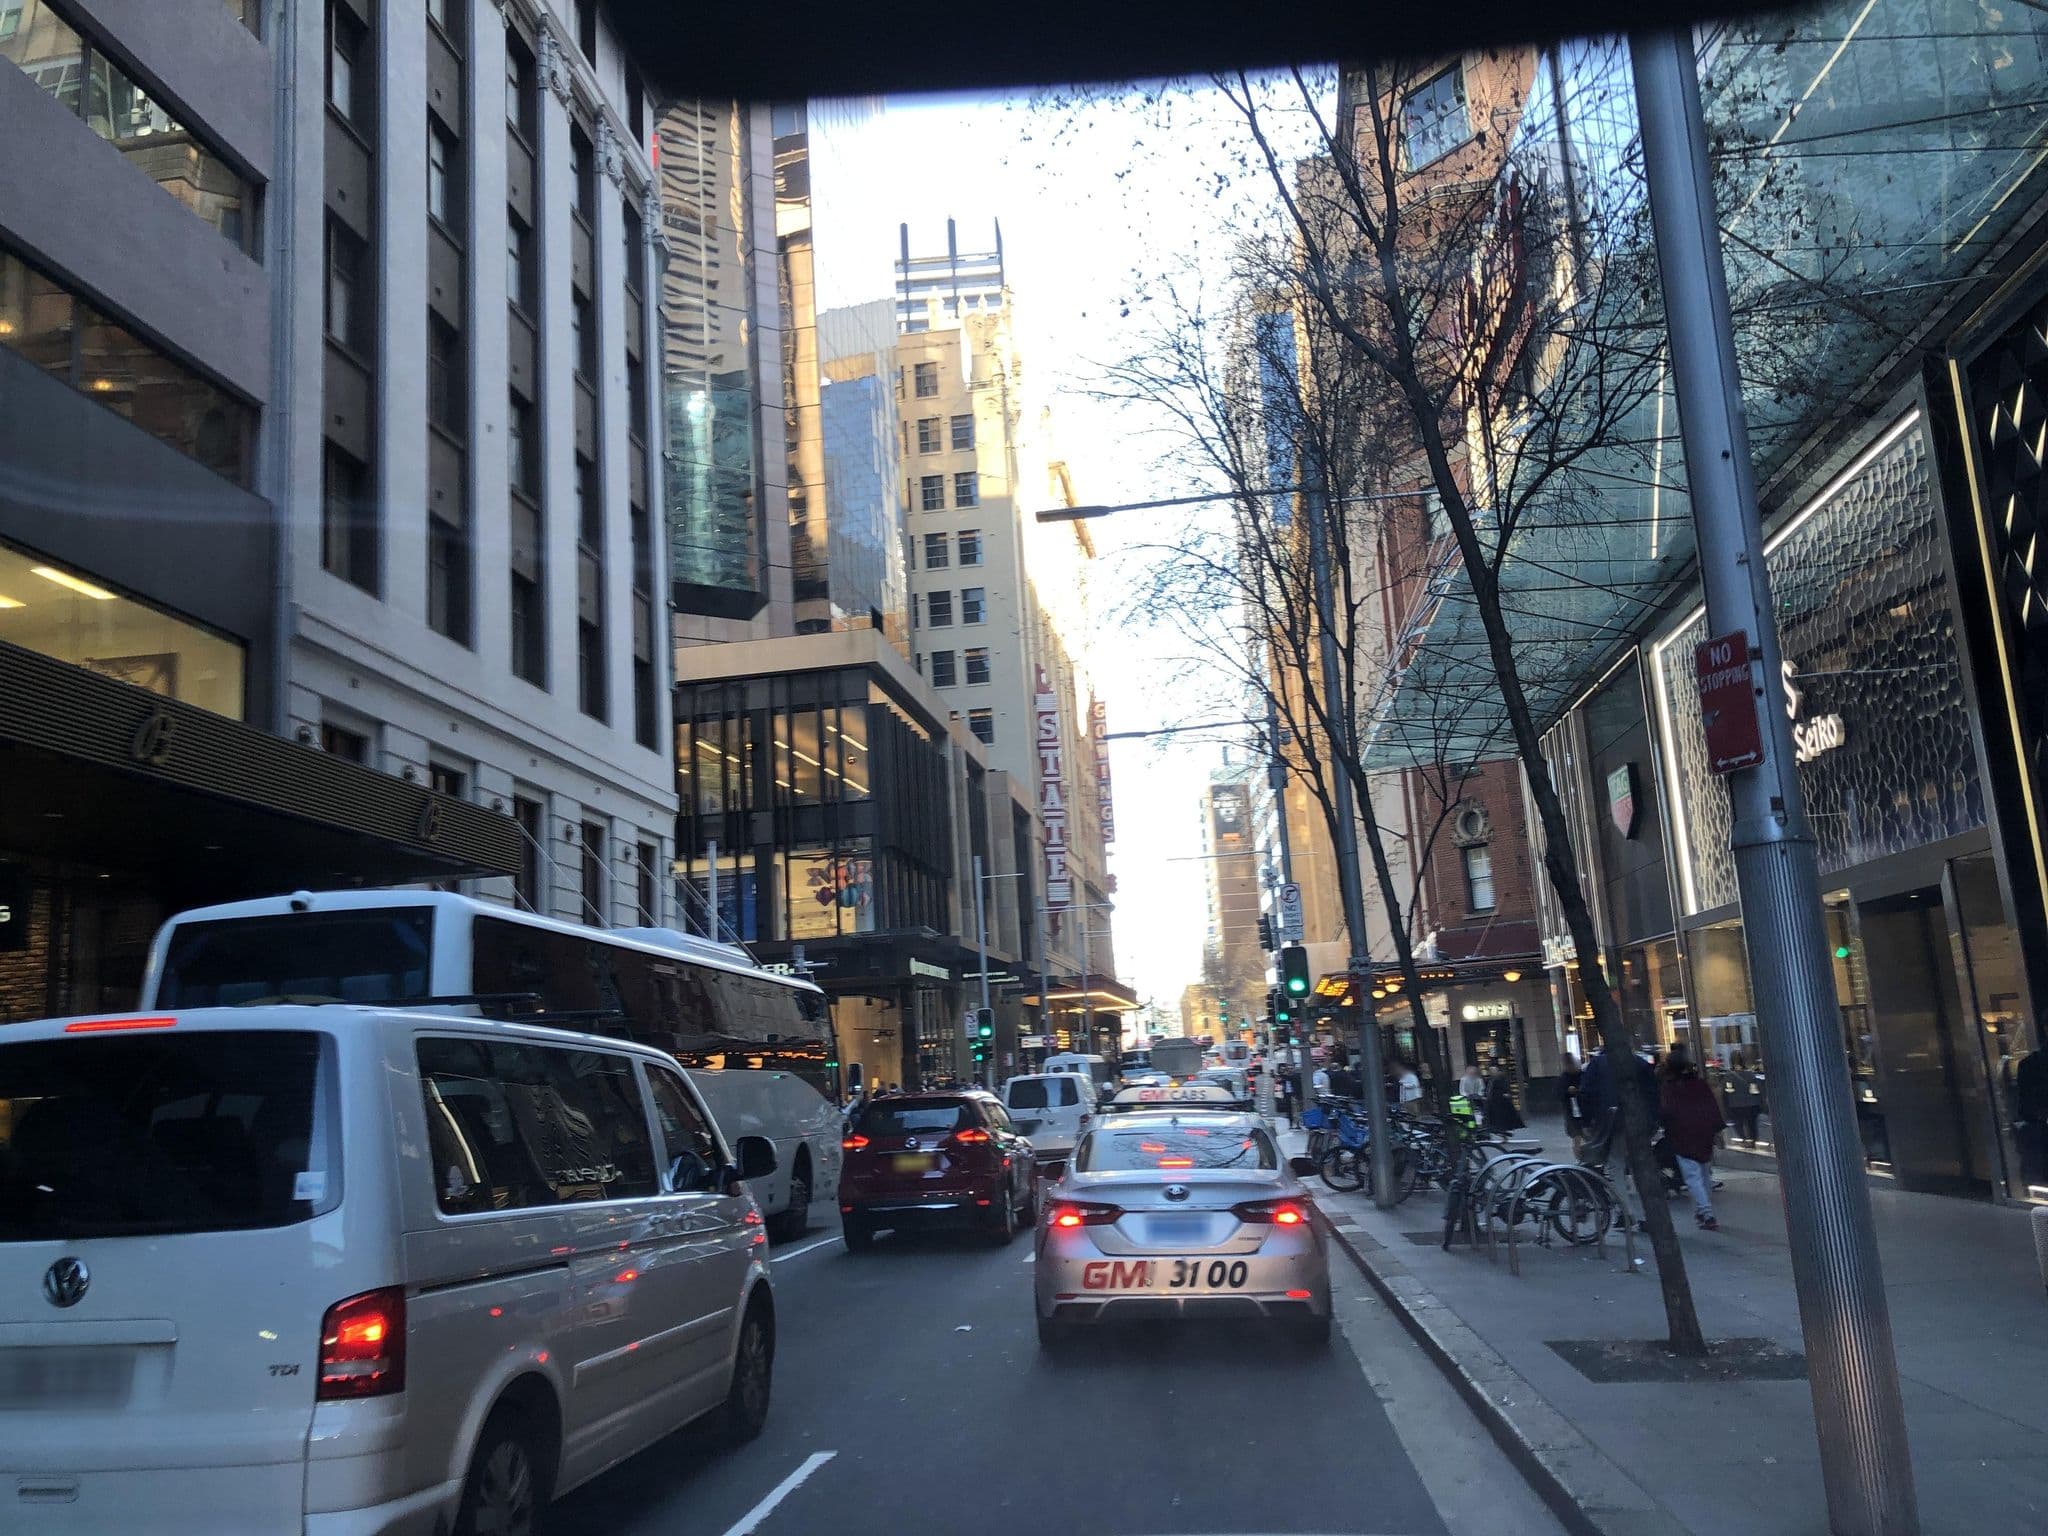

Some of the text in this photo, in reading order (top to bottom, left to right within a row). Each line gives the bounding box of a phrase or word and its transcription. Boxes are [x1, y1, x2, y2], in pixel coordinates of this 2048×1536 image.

[1710, 642, 1732, 668] NO
[1701, 664, 1750, 694] STOPPING
[1794, 715, 1840, 758] Seiko
[1039, 714, 1067, 881] STATE
[1139, 1090, 1207, 1101] GM CABS
[1083, 1261, 1148, 1289] GM
[270, 1364, 299, 1376] TDI
